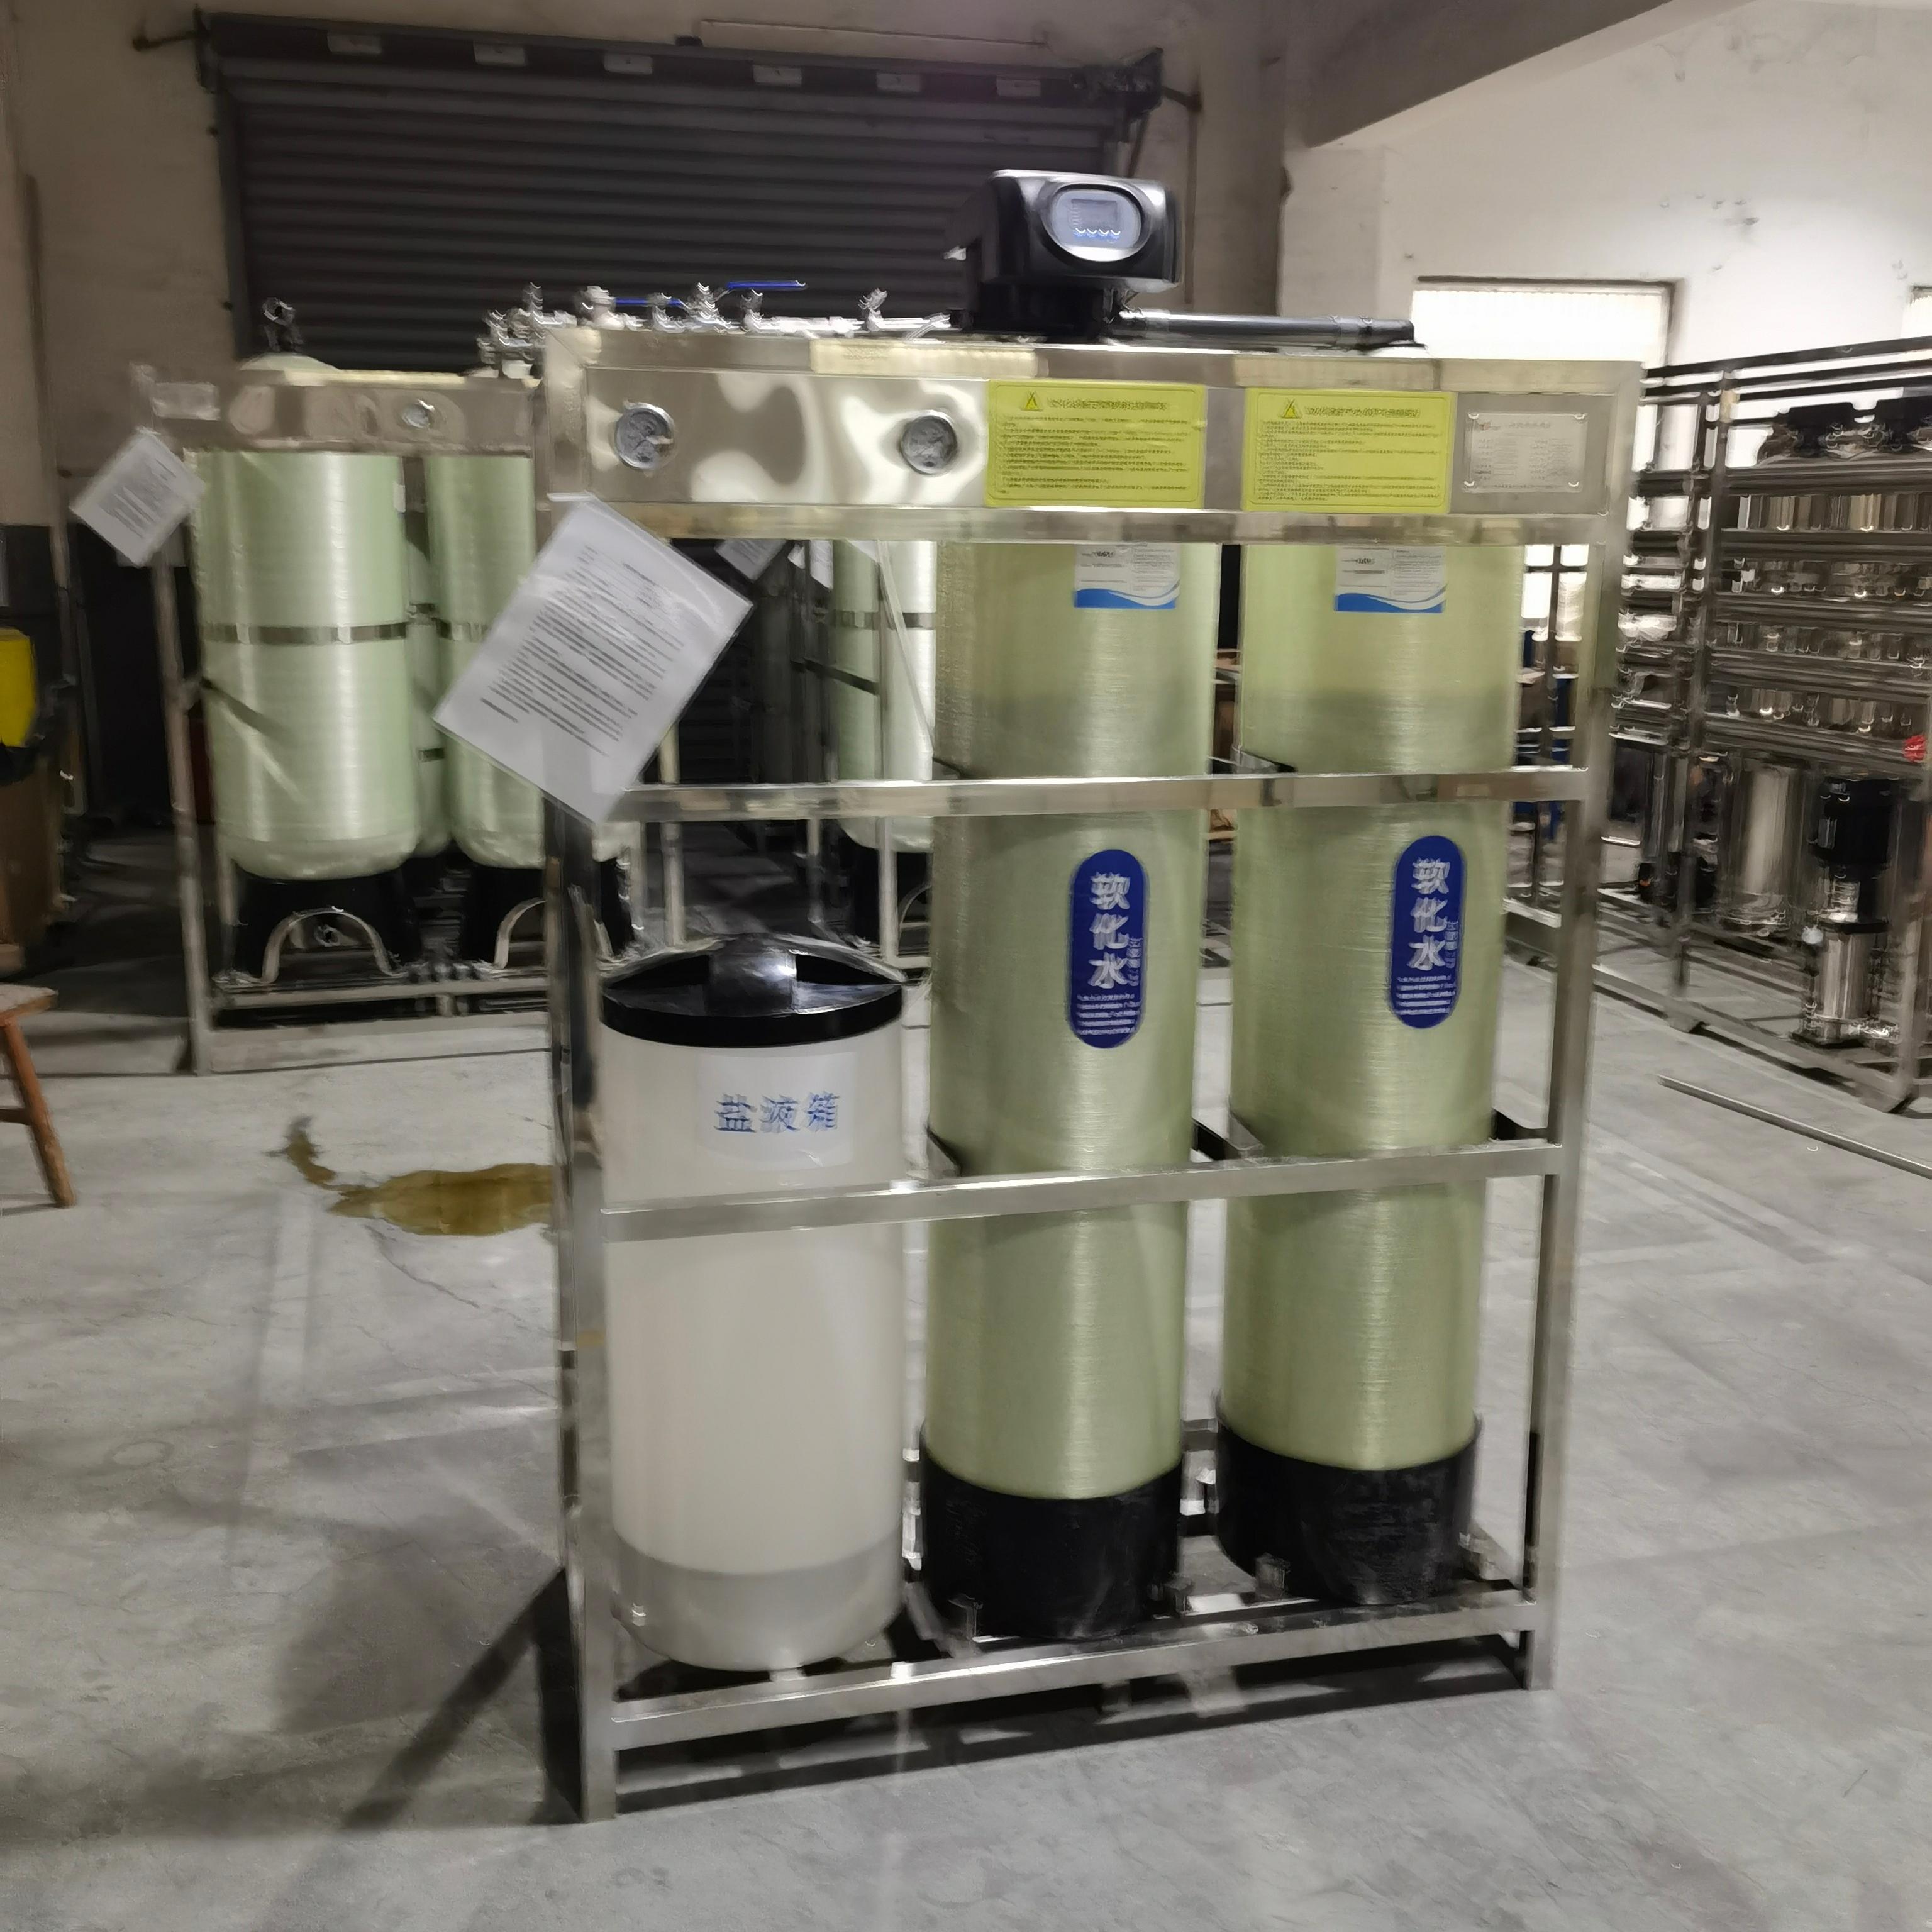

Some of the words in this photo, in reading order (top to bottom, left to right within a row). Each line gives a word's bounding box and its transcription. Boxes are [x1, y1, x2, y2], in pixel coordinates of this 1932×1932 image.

[1089, 872, 1130, 989] 软化水
[1407, 858, 1450, 970] 软化水
[714, 1091, 840, 1133] 盐液箱
